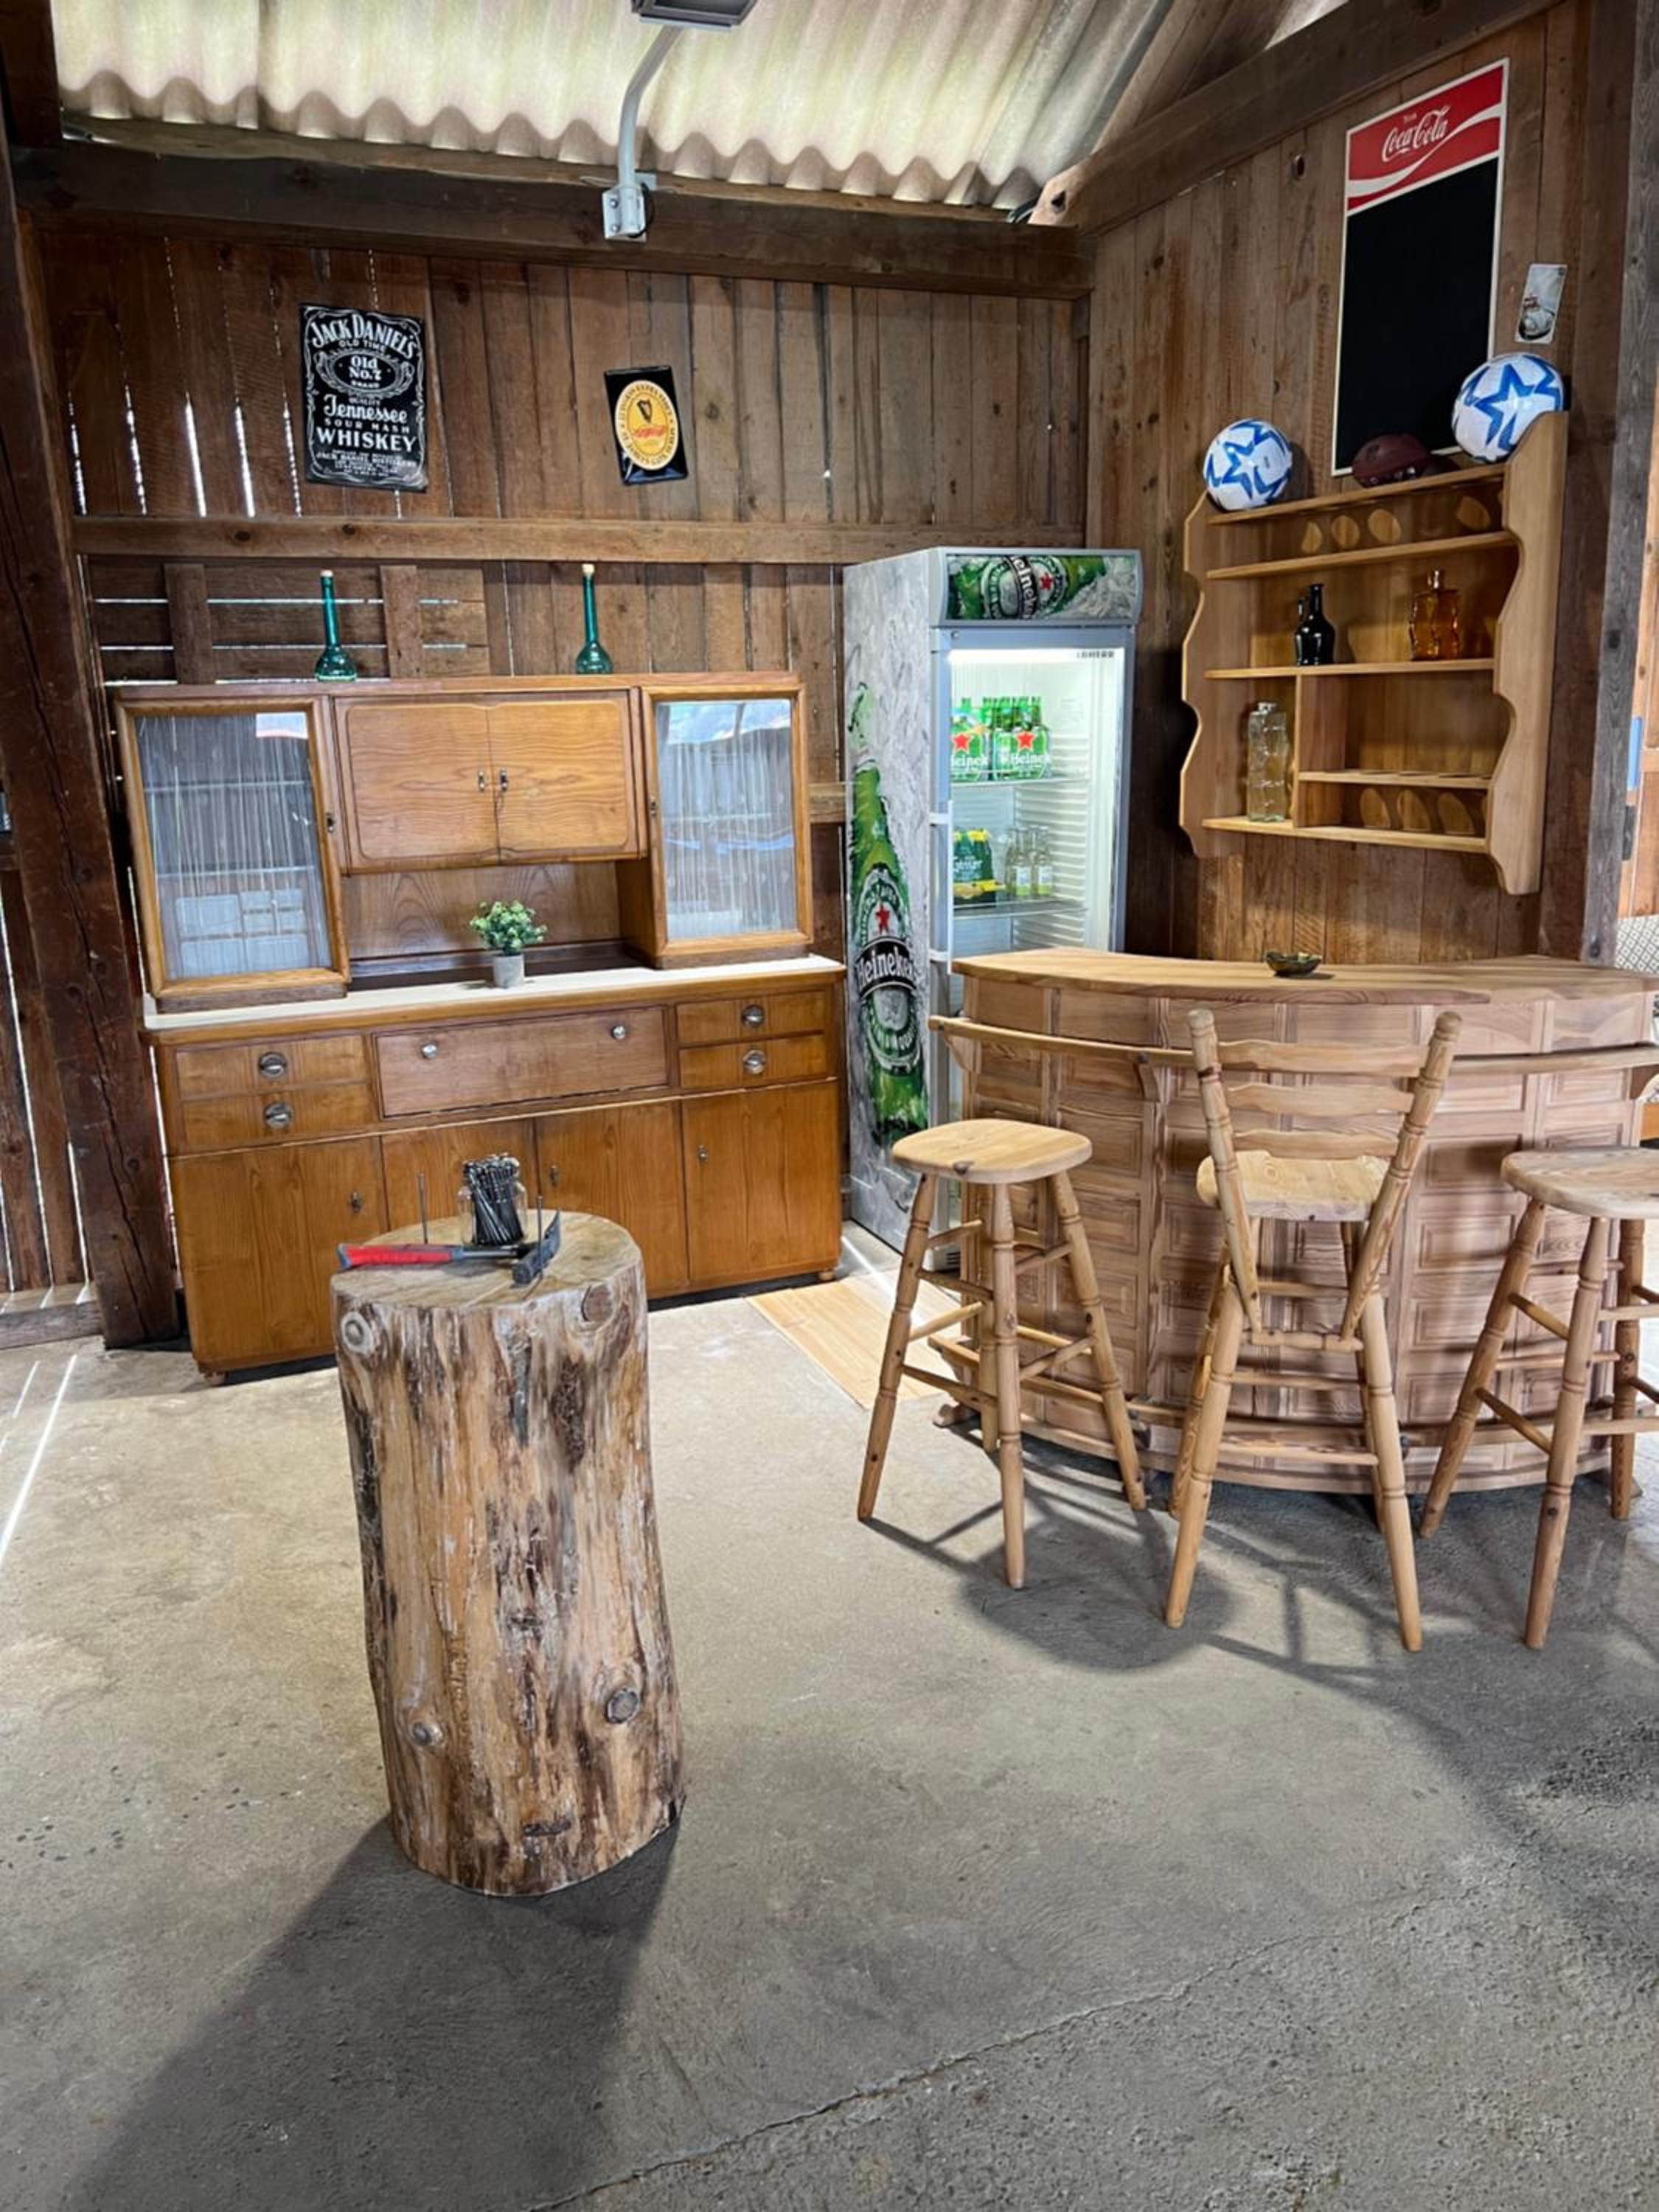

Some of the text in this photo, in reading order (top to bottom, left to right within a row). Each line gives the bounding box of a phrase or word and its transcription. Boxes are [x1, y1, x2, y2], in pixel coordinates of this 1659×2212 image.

[310, 313, 417, 359] JACK DANIEL'S
[338, 340, 386, 353] OLD TIME
[350, 355, 378, 369] Old
[323, 393, 408, 424] Tennessee
[324, 417, 409, 434] SOUR MASH
[316, 426, 417, 453] WHISKEY
